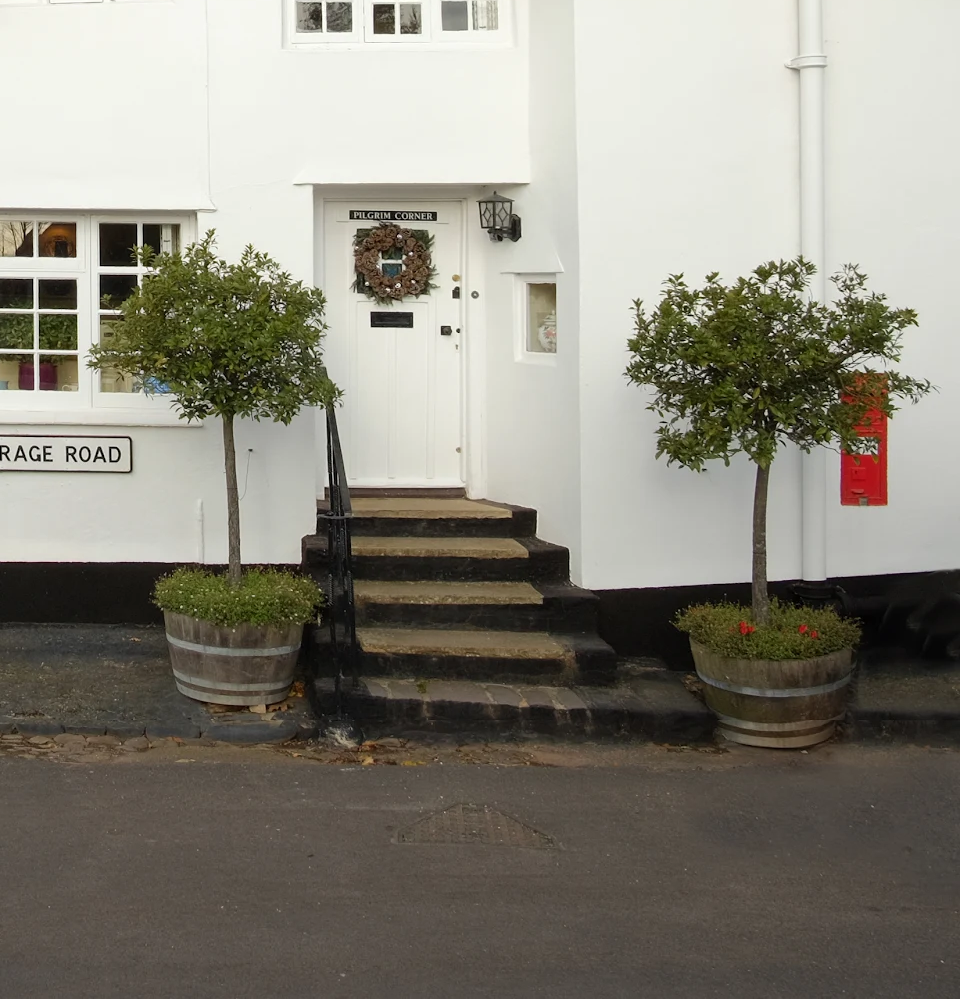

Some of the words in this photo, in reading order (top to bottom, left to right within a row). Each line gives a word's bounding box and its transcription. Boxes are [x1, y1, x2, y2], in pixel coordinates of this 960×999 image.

[353, 211, 391, 220] PILGRIM
[394, 212, 433, 220] CORNER
[65, 446, 122, 463] ROAD
